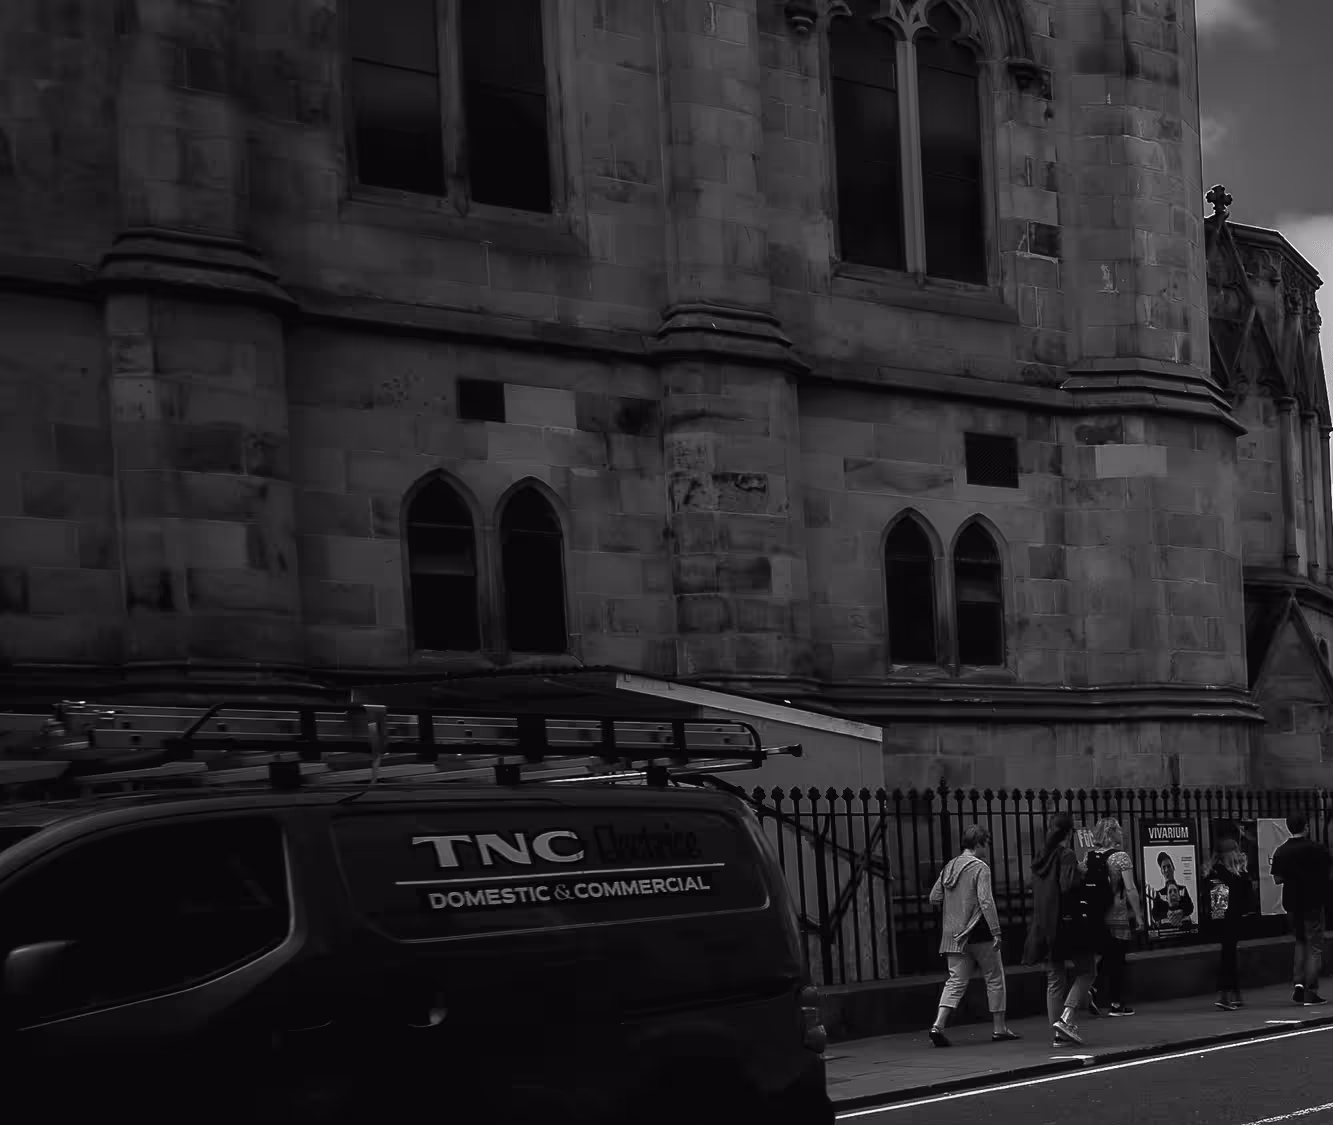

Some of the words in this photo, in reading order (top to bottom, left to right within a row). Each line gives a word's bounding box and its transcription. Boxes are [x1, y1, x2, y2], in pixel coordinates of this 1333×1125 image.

[411, 830, 585, 868] TNC
[1148, 826, 1189, 839] VIVARIUM
[428, 885, 551, 911] DOMESTIC
[552, 883, 575, 900] &
[574, 876, 711, 900] COMMERCIAL
